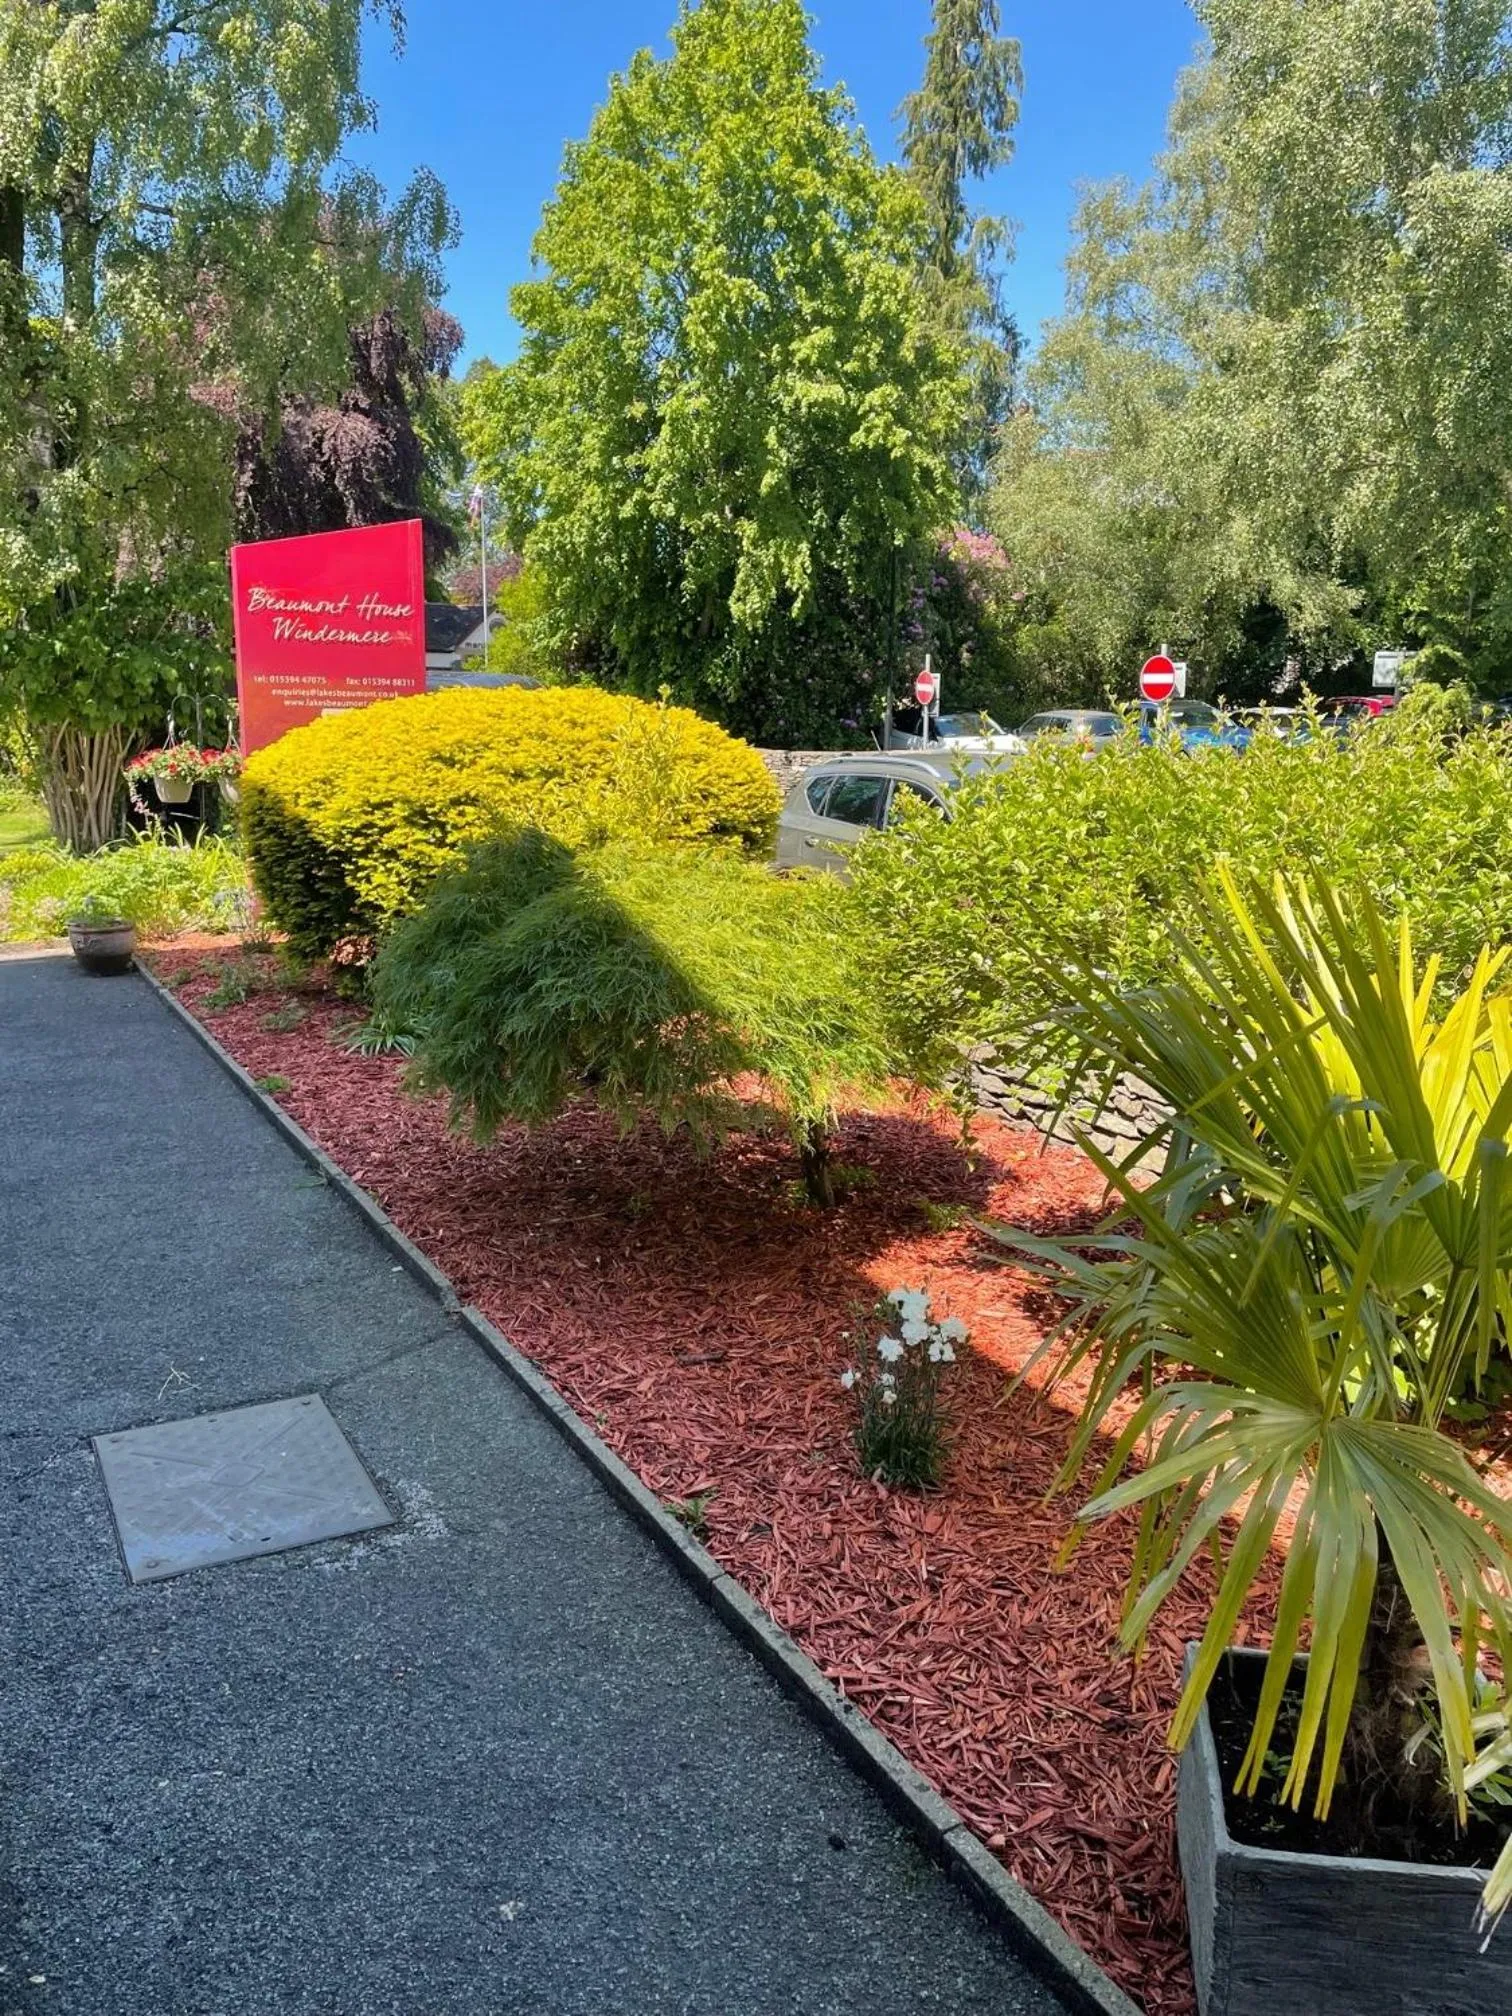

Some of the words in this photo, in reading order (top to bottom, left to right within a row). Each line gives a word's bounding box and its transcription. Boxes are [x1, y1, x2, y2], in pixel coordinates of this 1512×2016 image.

[247, 587, 351, 615] Beaumont
[356, 592, 415, 620] House
[273, 616, 392, 643] Windermere
[269, 675, 300, 684] 015394
[346, 677, 361, 685] fax:
[362, 677, 391, 686] 015394
